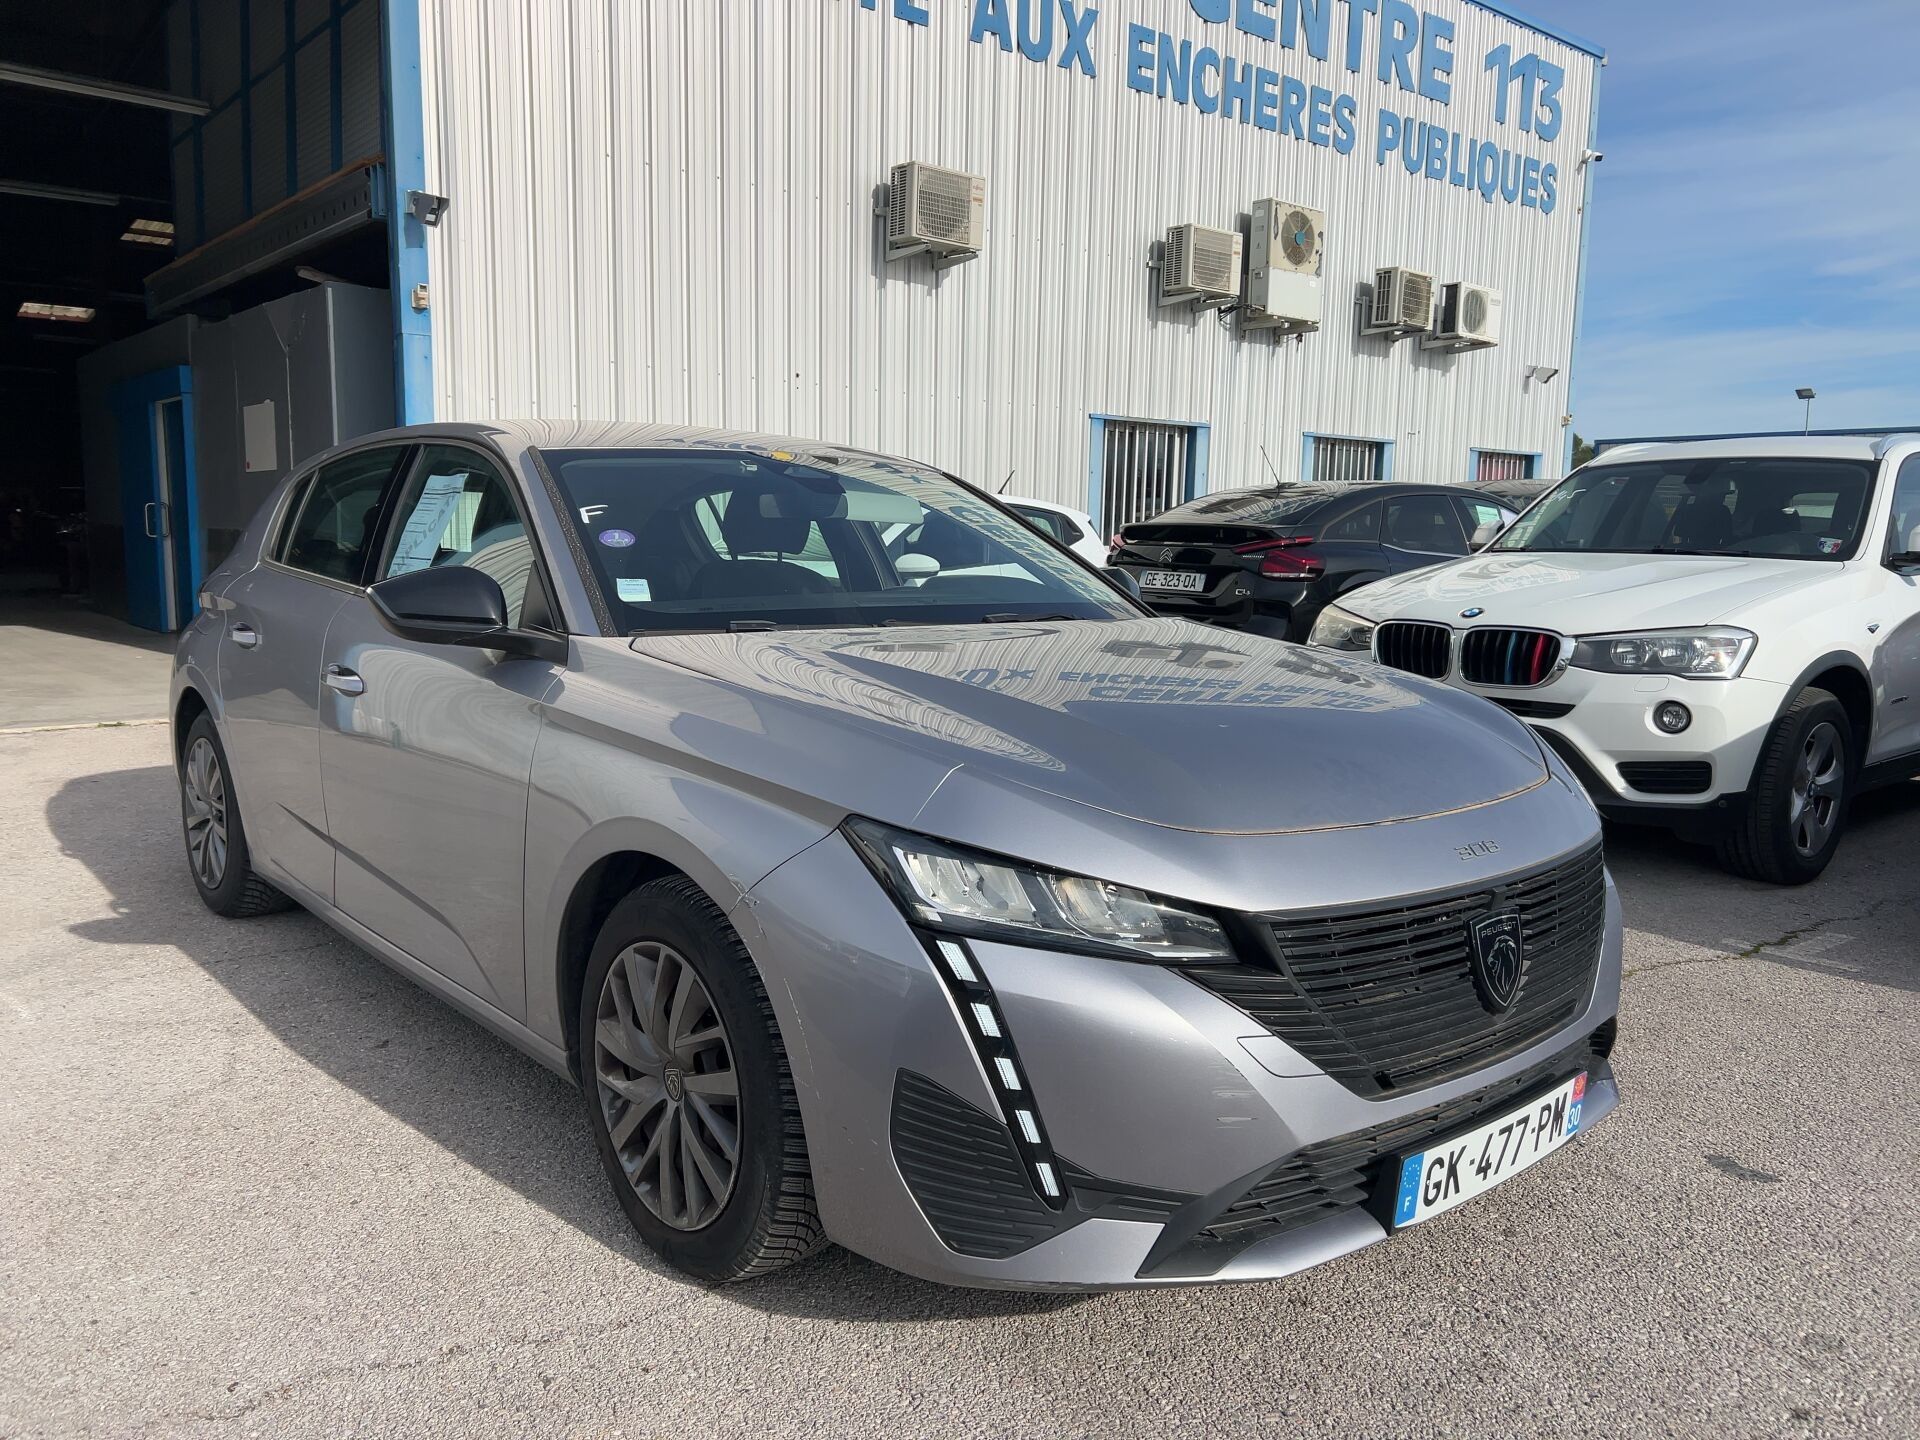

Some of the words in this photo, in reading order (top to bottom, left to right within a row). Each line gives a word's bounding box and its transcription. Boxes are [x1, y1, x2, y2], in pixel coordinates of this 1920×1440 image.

[969, 0, 1099, 79] AUX
[1127, 22, 1356, 155] ENCHERES
[1377, 108, 1557, 214] PUBLIQUES
[1189, 0, 1455, 106] NTRE
[1484, 43, 1565, 142] 113
[1455, 839, 1500, 861] 308
[1481, 921, 1517, 939] PEUGEOT
[1403, 1196, 1412, 1213] F
[1422, 1091, 1568, 1208] GK-477-PM
[1567, 1103, 1582, 1129] 30
